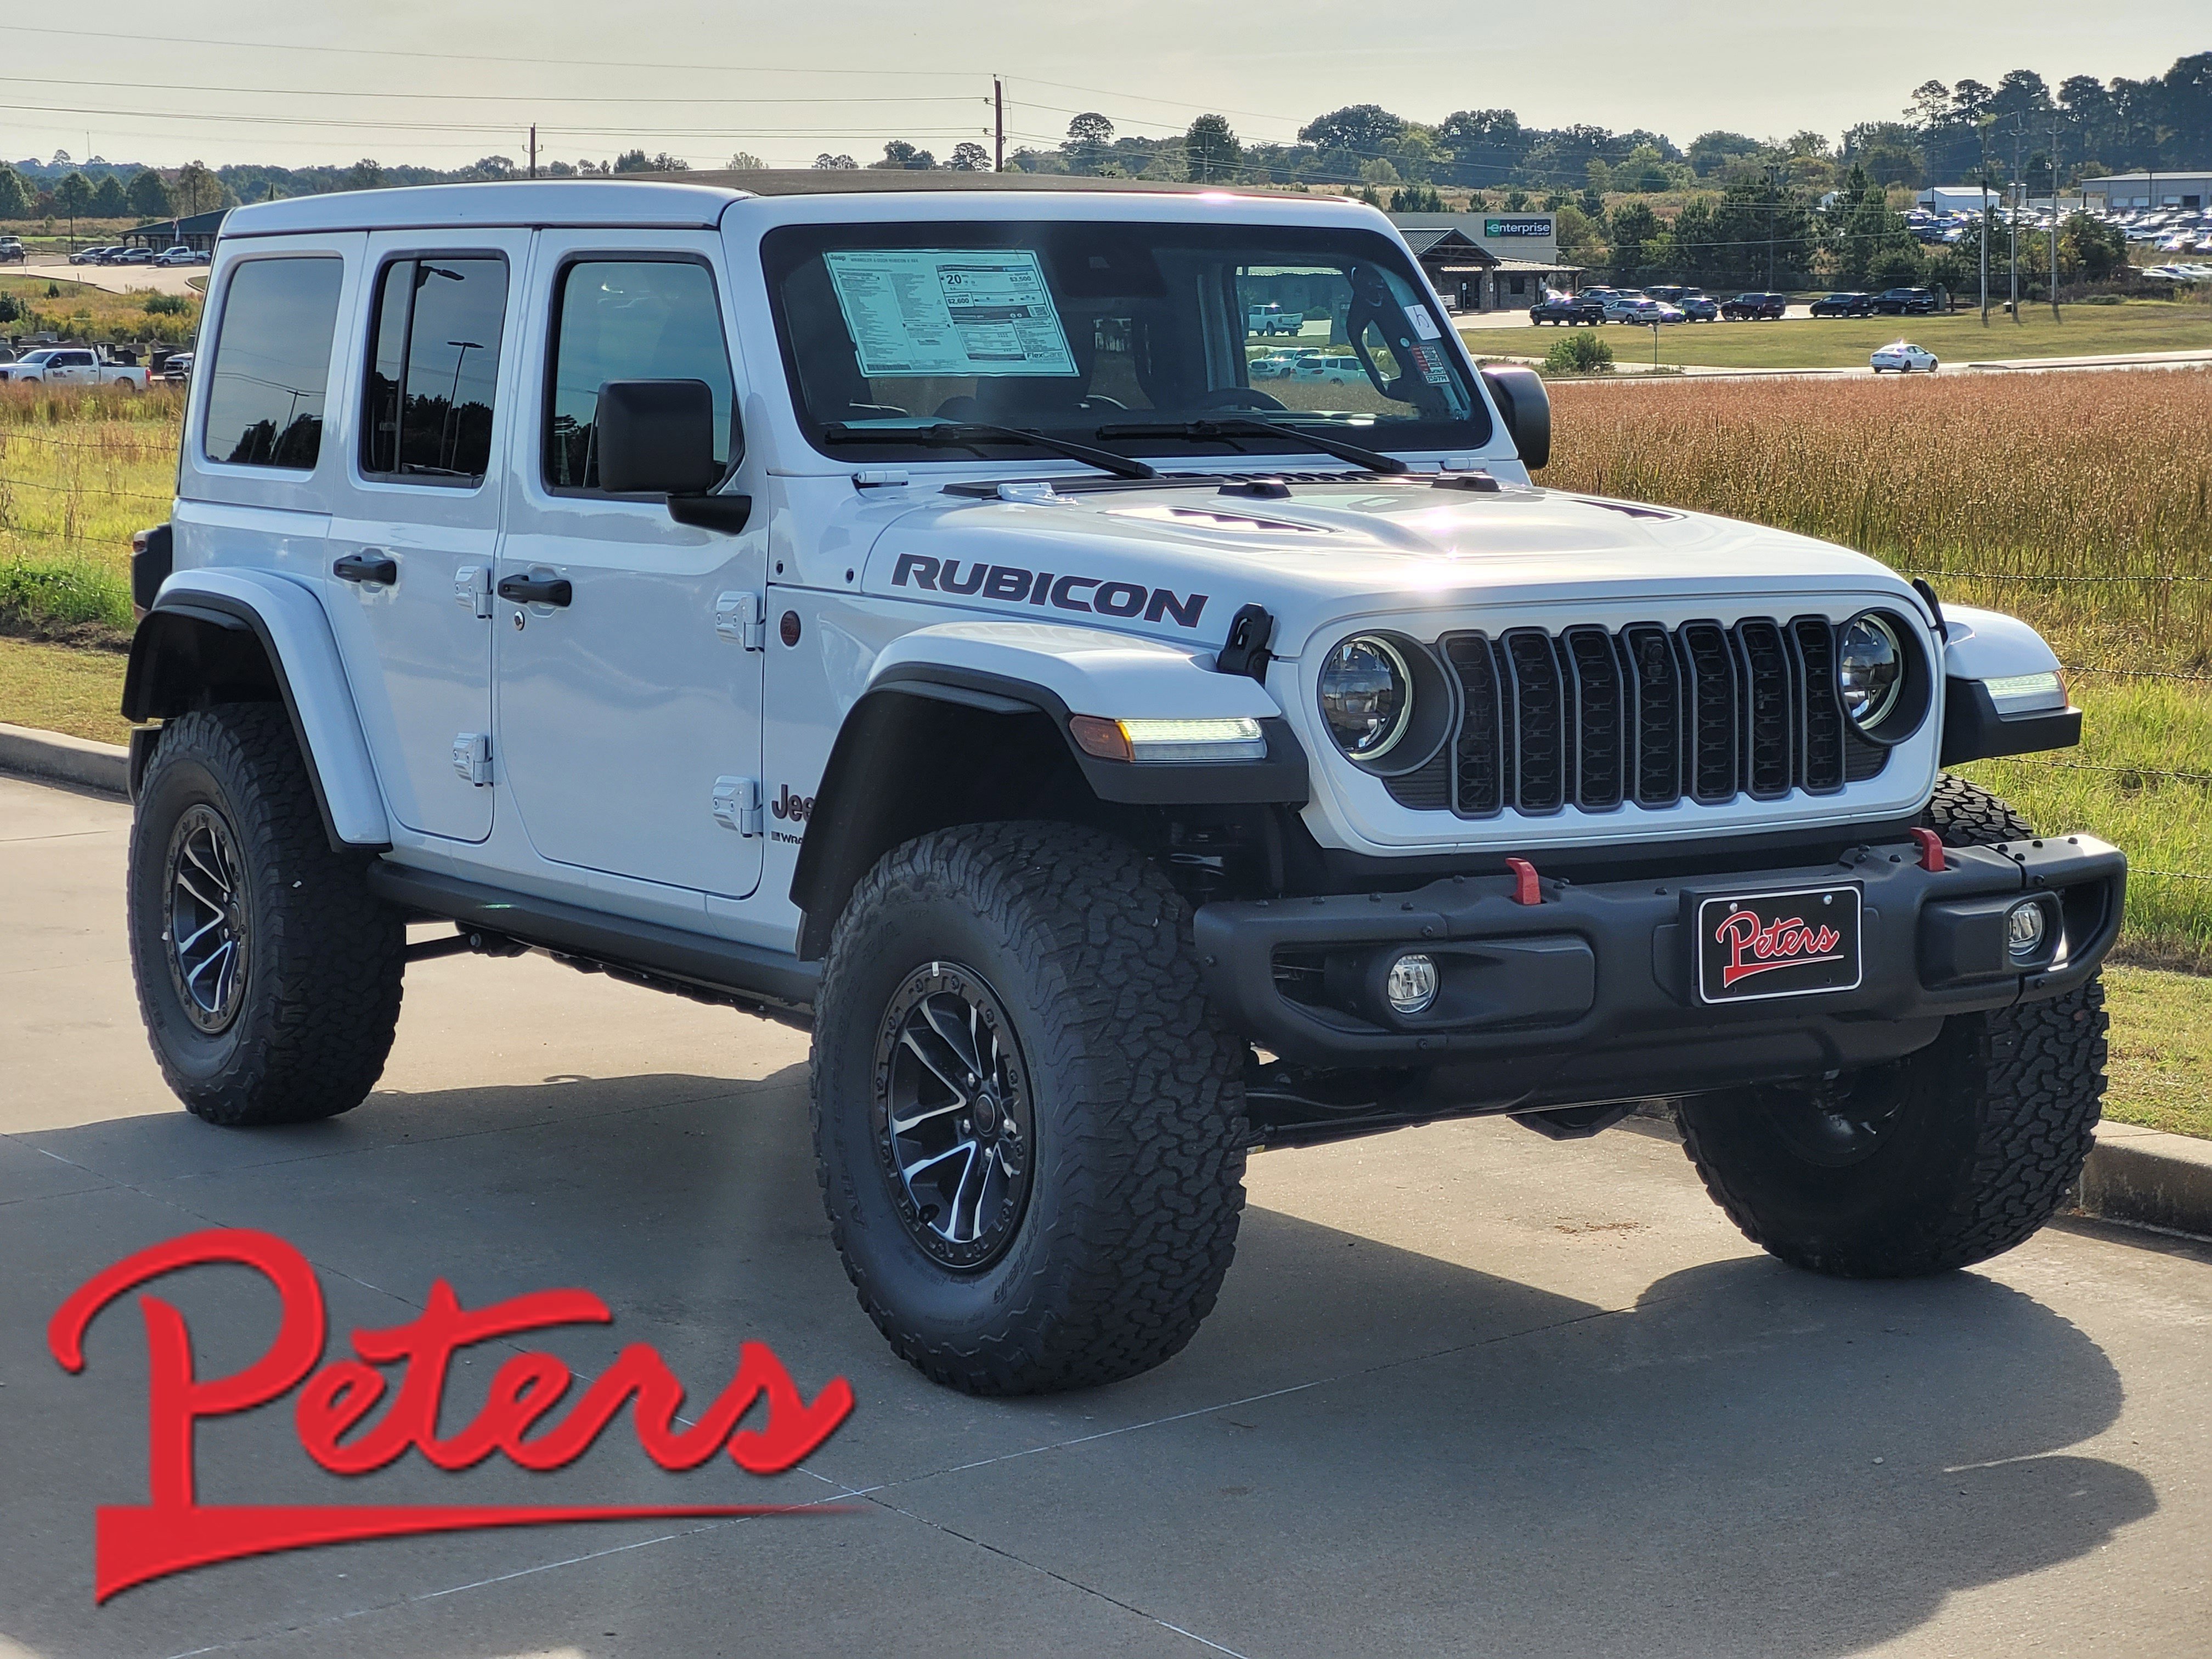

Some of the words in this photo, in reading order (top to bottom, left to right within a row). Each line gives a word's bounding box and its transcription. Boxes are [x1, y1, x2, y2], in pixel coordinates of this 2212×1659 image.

[1487, 222, 1550, 234] enterprise
[946, 274, 962, 285] 20
[890, 552, 1210, 629] RUBICON
[771, 783, 815, 822] Jee
[1716, 911, 1844, 988] Peters
